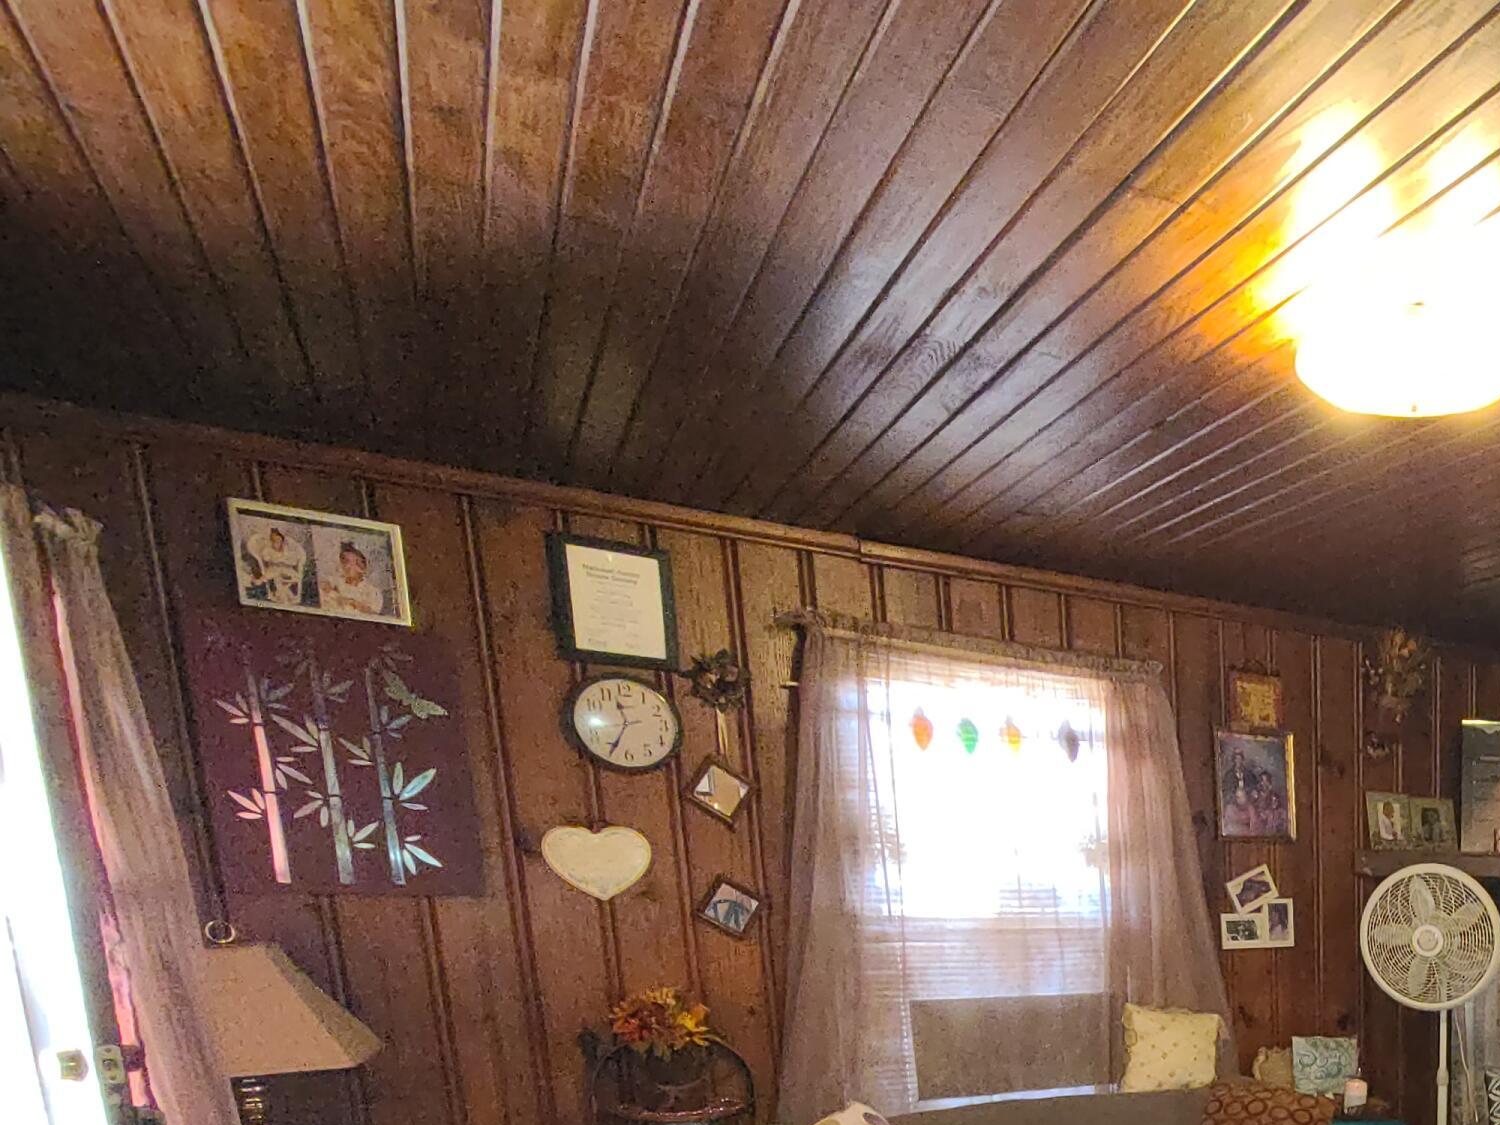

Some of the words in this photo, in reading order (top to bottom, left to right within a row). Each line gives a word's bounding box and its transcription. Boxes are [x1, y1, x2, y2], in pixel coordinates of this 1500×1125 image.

[600, 687, 612, 701] 11
[616, 683, 632, 697] 12
[652, 704, 662, 718] 2
[659, 719, 669, 732] 3
[624, 749, 635, 761] 6
[643, 743, 653, 758] 5
